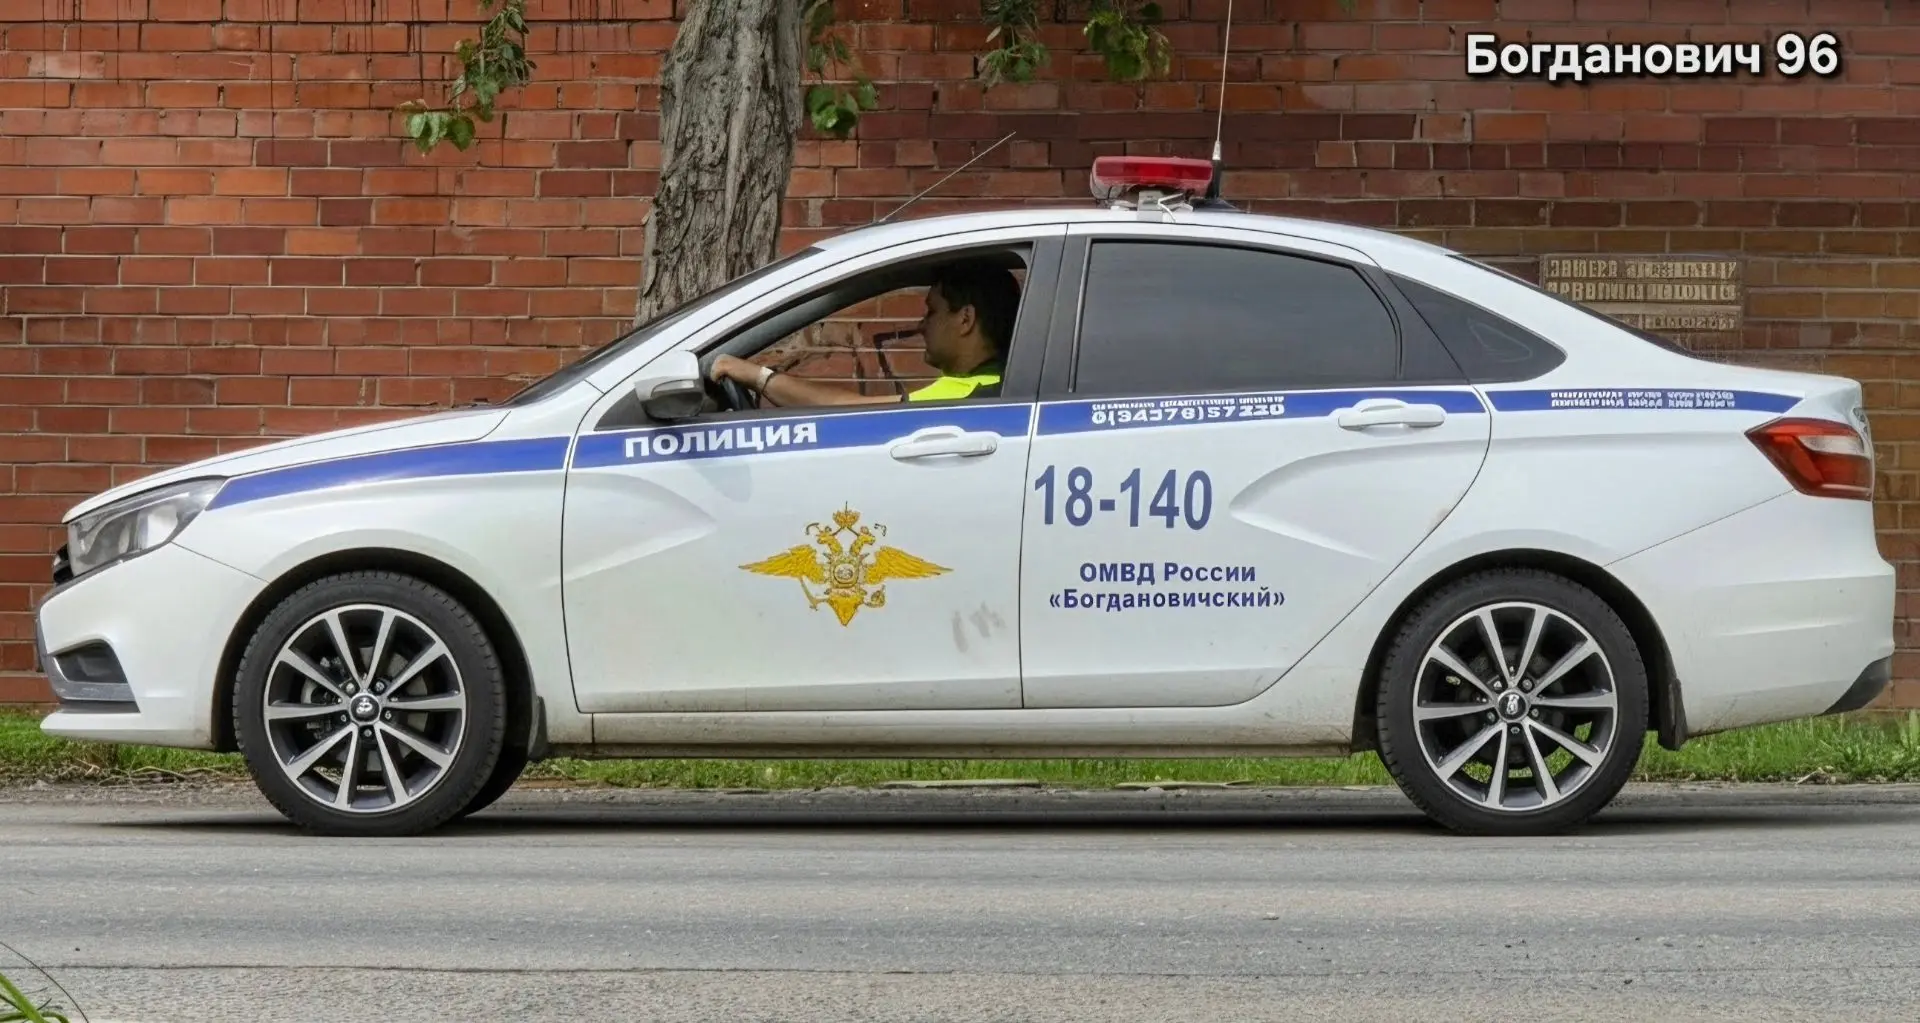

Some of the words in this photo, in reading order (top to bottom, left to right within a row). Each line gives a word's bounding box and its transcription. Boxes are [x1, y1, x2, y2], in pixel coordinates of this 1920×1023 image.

[625, 422, 817, 458] ПОЛИЦИЯ
[1034, 464, 1212, 530] 18-140
[1079, 562, 1156, 586] ОМВД
[1163, 562, 1256, 582] России
[1049, 586, 1286, 612] «Богдановичский»
